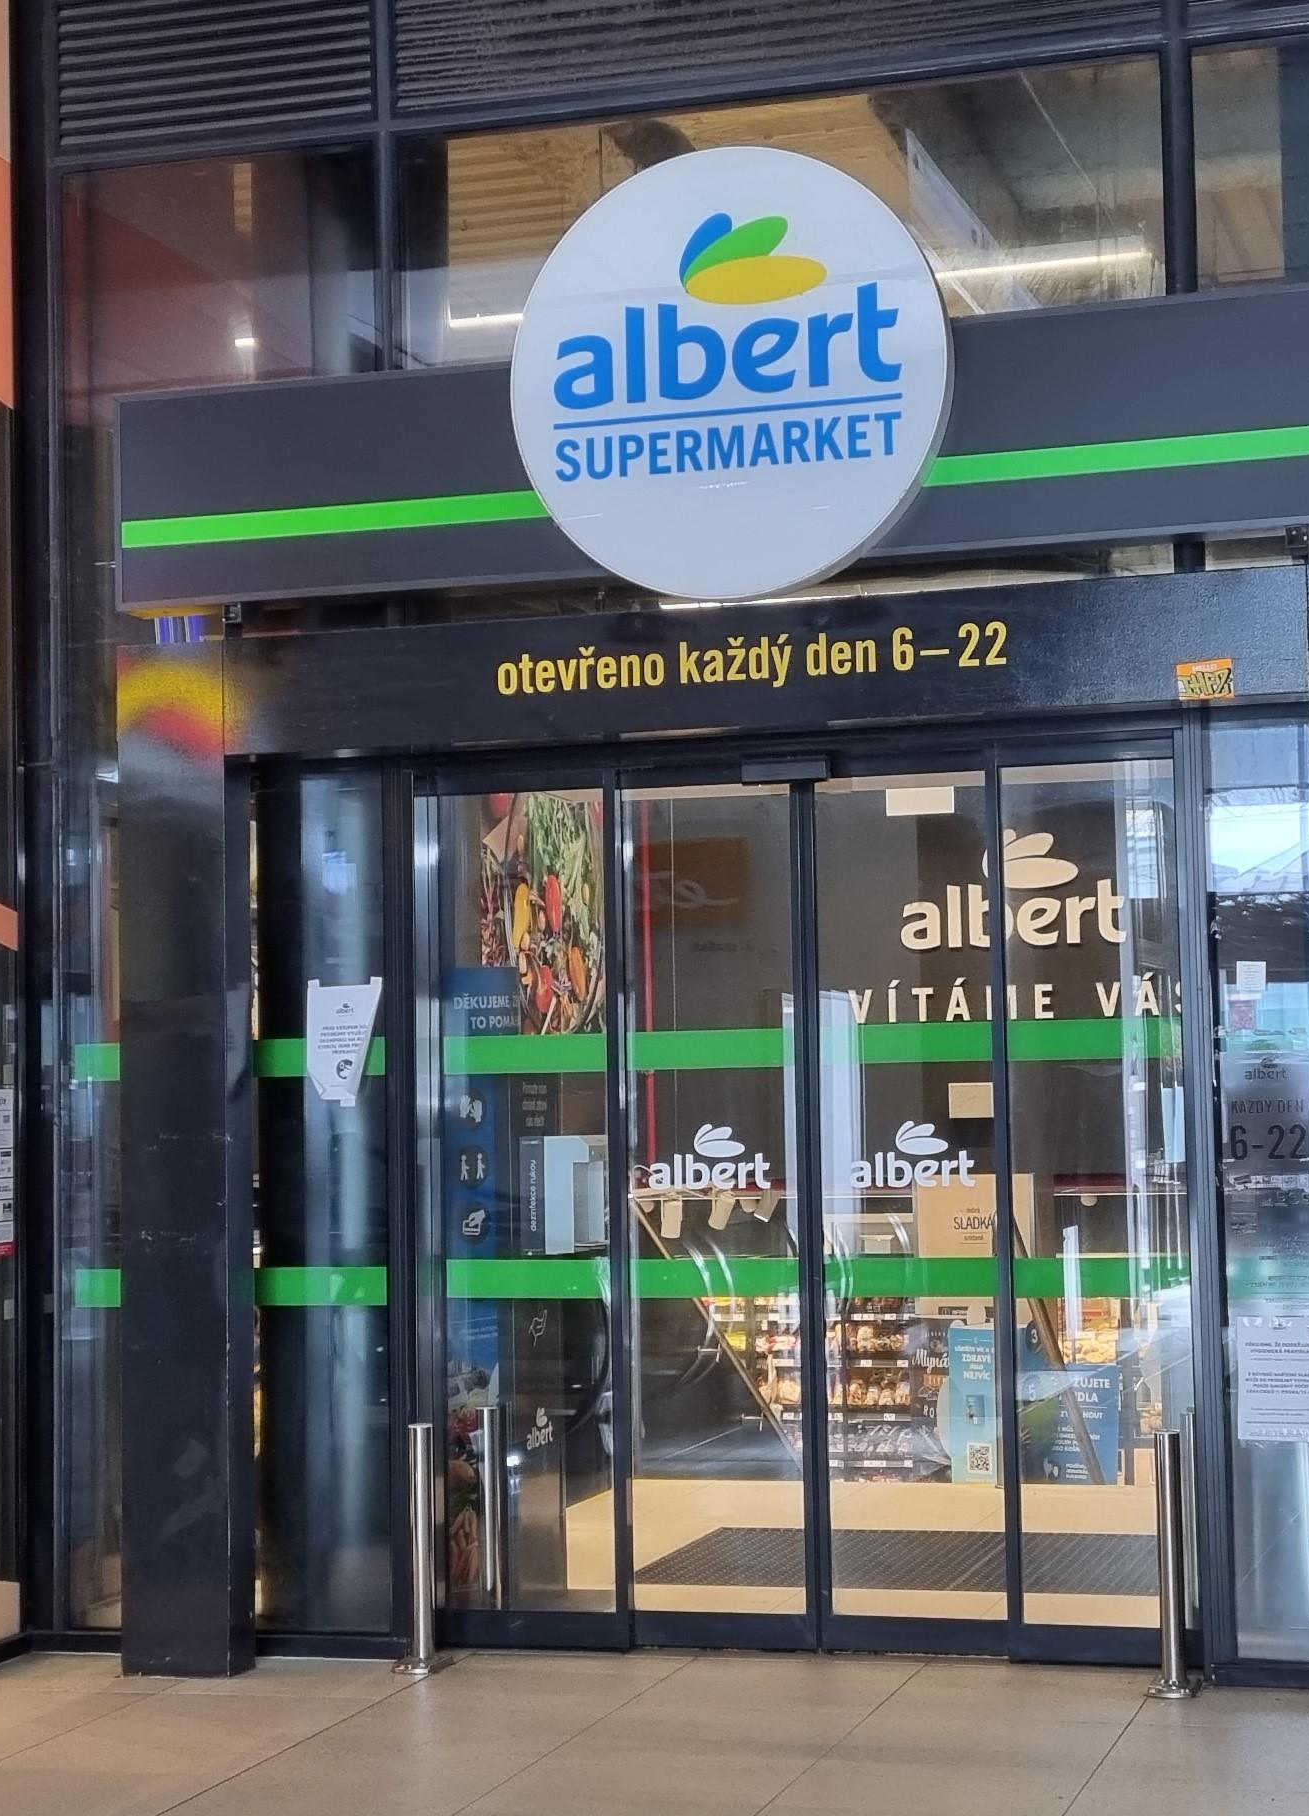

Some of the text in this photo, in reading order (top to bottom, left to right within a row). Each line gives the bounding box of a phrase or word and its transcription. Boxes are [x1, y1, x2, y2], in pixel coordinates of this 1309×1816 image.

[553, 282, 902, 410] albert
[554, 411, 902, 483] SUPERMARKET
[497, 646, 665, 695] otevřeno
[678, 633, 793, 688] každý
[806, 632, 876, 676] den
[901, 878, 1127, 950] albert
[470, 1015, 487, 1029] TO
[1245, 1068, 1289, 1081] albert
[1277, 1099, 1305, 1113] DEN
[648, 1153, 771, 1190] albert
[850, 1151, 976, 1189] albert
[526, 1421, 553, 1450] albert
